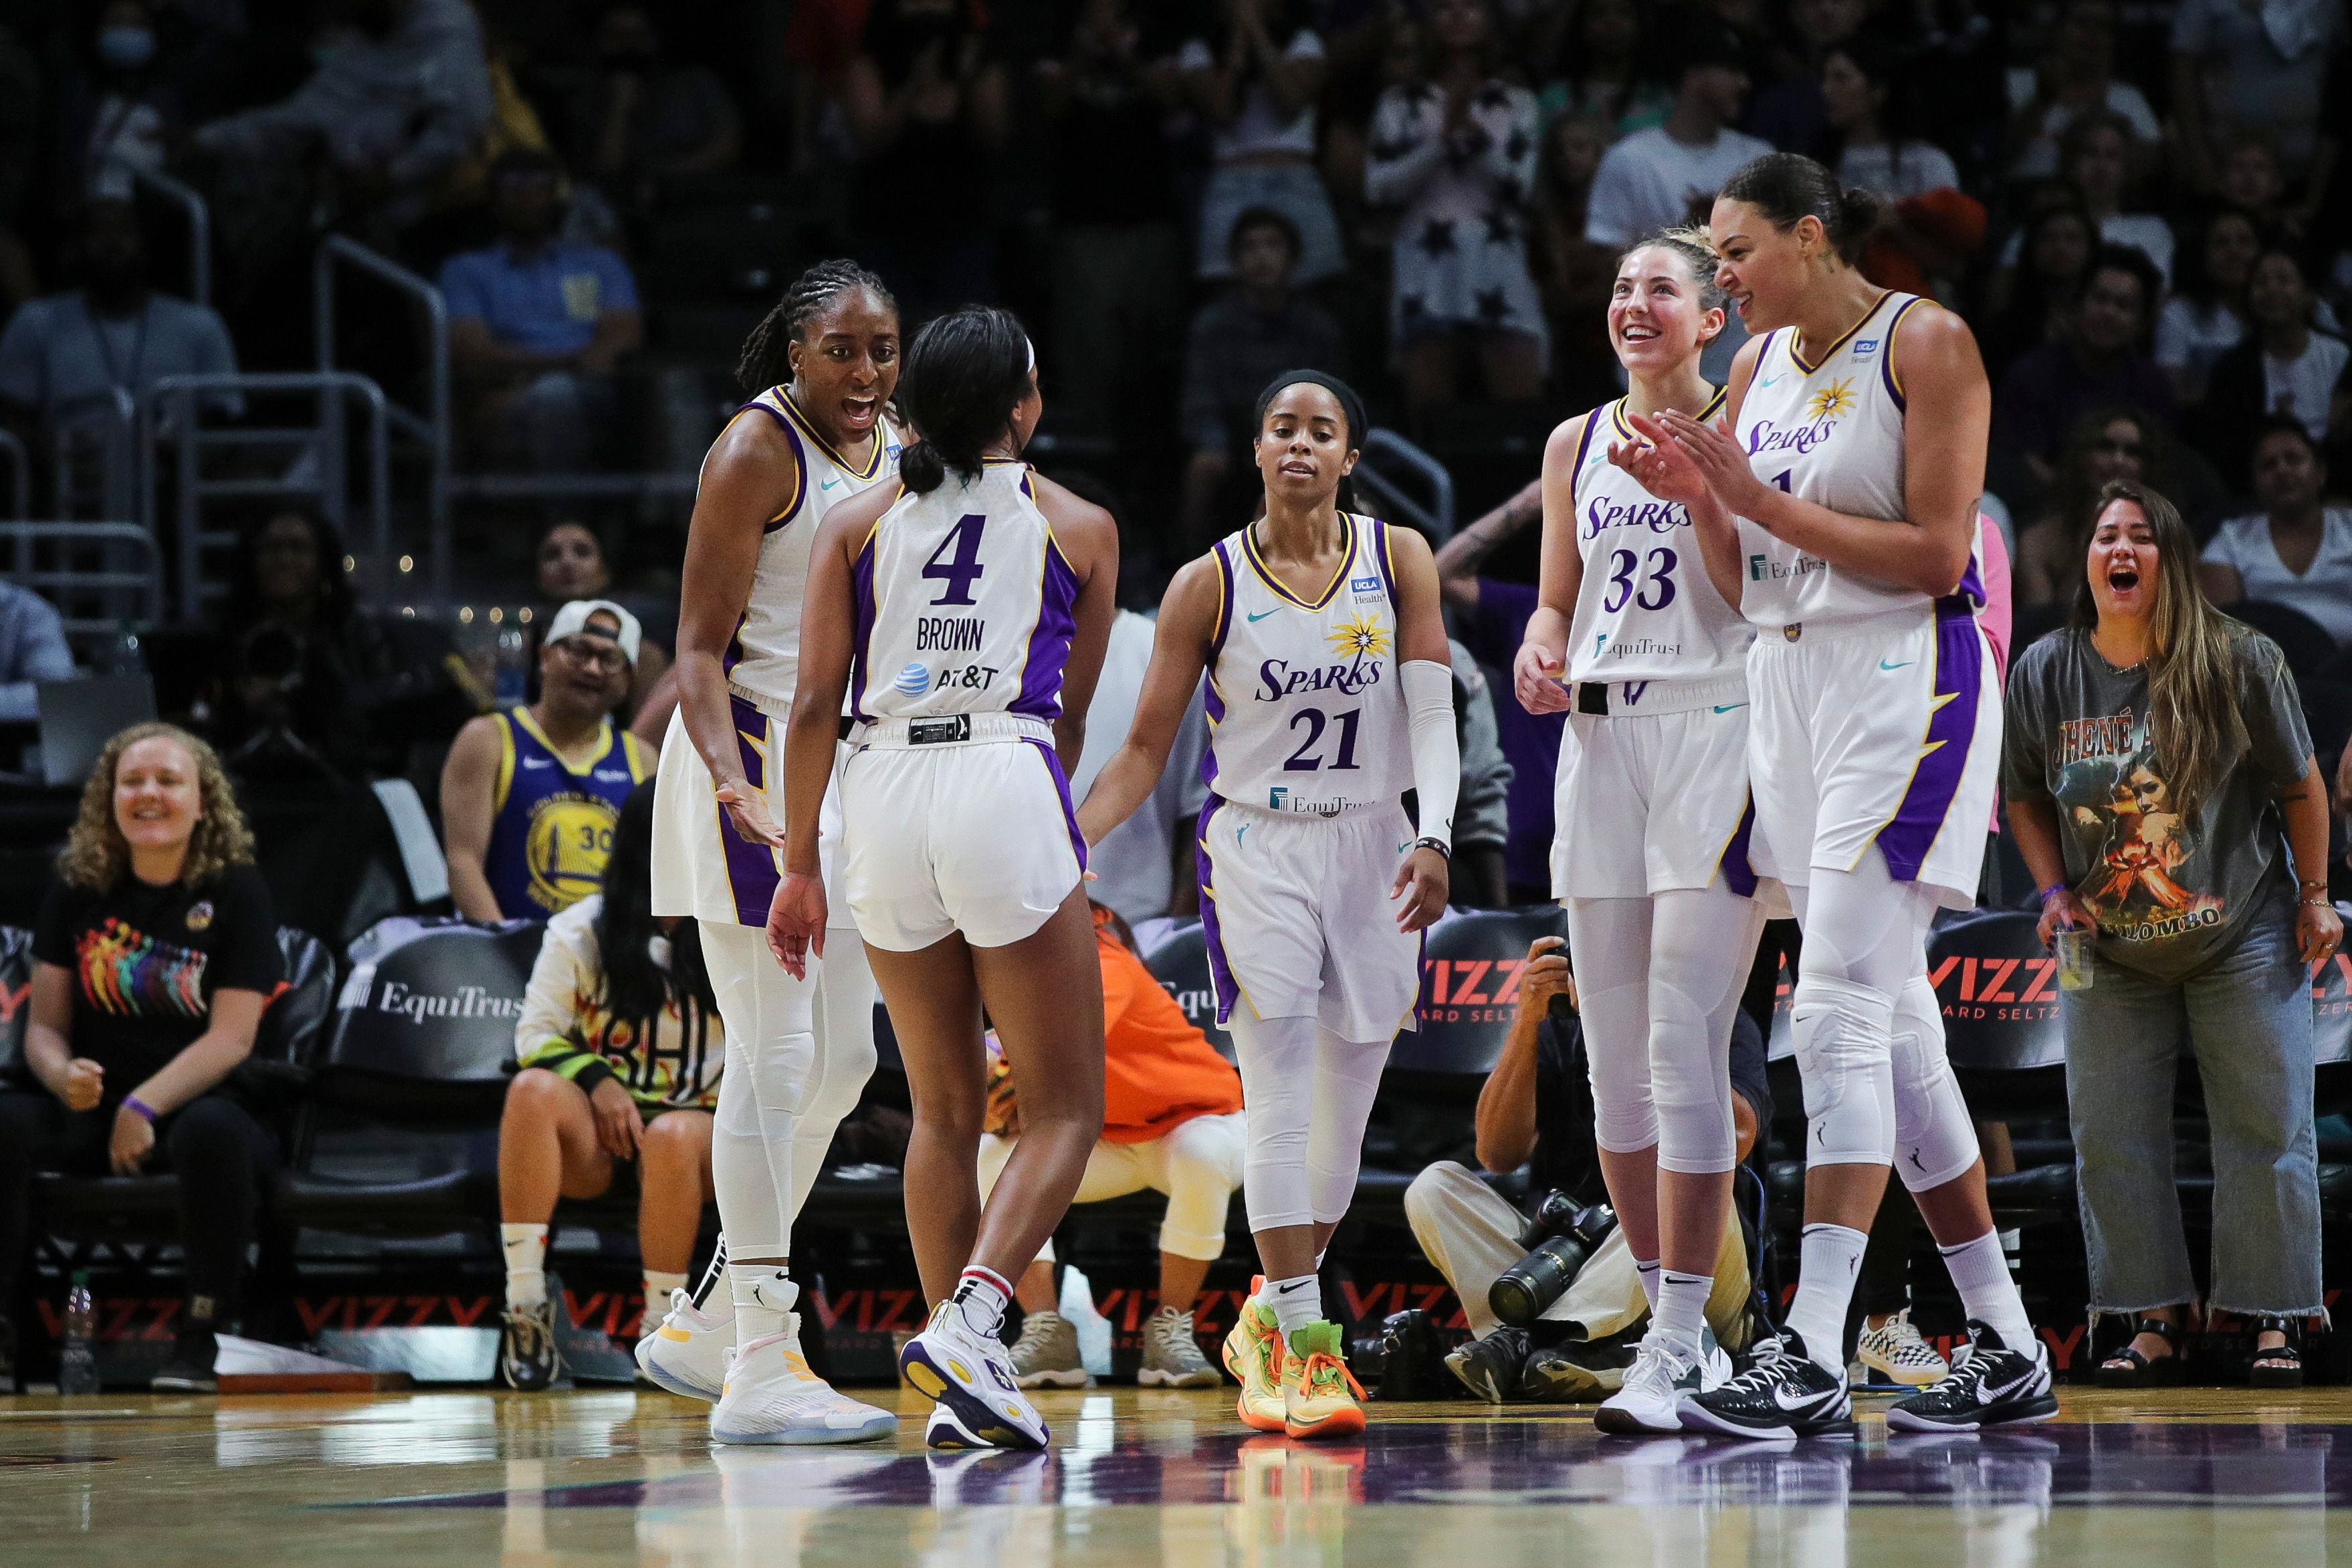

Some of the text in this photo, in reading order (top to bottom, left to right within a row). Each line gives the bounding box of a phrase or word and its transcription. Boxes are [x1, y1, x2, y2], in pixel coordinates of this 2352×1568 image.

[1747, 420, 1838, 455] SPARKS
[922, 514, 987, 606] 4
[1604, 547, 1678, 613] 33
[1354, 580, 1378, 590] UCLA
[916, 617, 985, 652] BROWN
[934, 665, 999, 691] AT&T
[1254, 659, 1384, 702] SPARKS
[1283, 707, 1361, 772] 21
[1425, 959, 1527, 1004] IZZ
[1927, 956, 2058, 1003] VIZZ
[379, 981, 524, 1025] EquiTrus
[1942, 1005, 2060, 1020] ARD SELTZ
